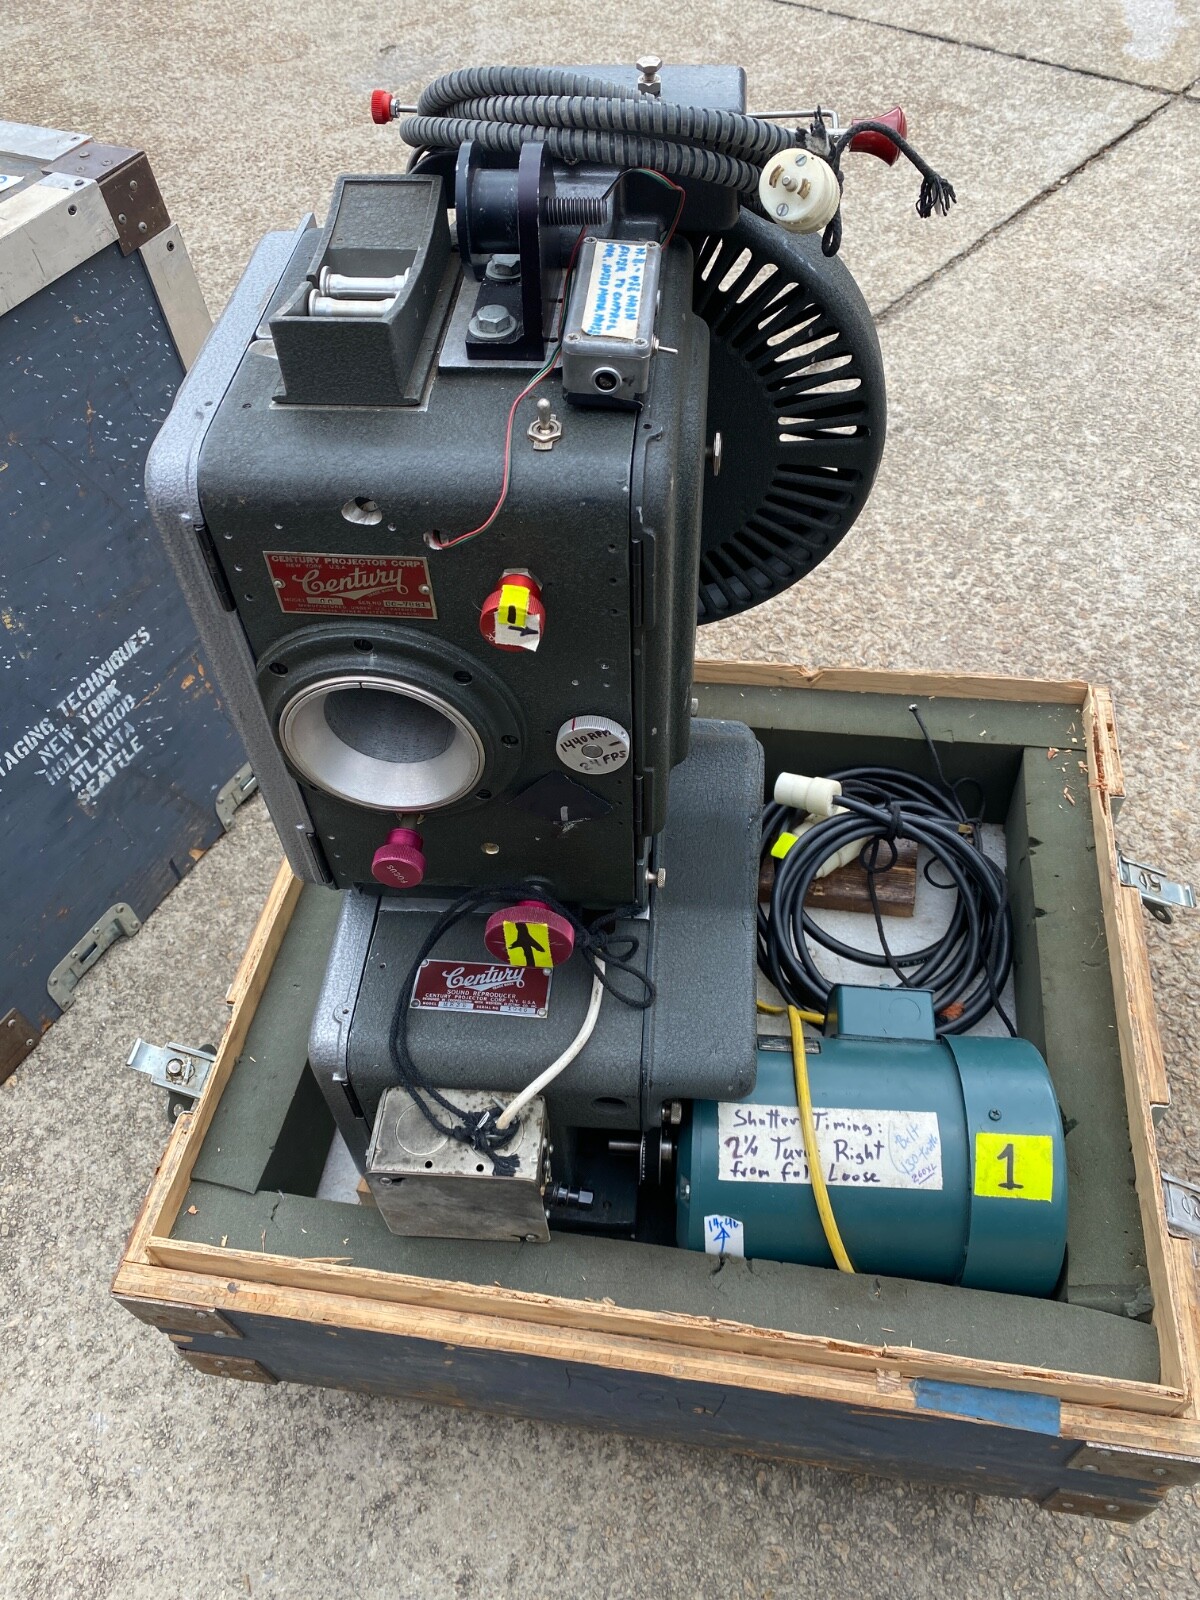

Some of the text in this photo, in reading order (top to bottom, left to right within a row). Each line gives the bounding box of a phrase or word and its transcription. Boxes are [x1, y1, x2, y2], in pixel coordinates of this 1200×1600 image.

[614, 278, 626, 288] TO
[271, 555, 424, 568] CENTURY PROJECTOR CORP.
[291, 567, 409, 596] Century
[57, 626, 151, 718] TECHNIQUES
[38, 679, 121, 766] NEW YORK
[45, 694, 136, 786] HOLLYWOOD
[68, 721, 135, 792] ATLANTA
[602, 750, 627, 765] FPS
[77, 735, 144, 806] SEATTLE
[386, 864, 409, 884] FOCUS
[441, 966, 525, 989] Century
[454, 994, 488, 1002] PROJECTOR
[472, 990, 517, 999] REPRODUCER
[733, 1109, 801, 1130] Shutter
[833, 1139, 885, 1166] Right
[730, 1161, 770, 1178] from
[828, 1163, 881, 1183] Loose
[996, 1143, 1025, 1191] 1
